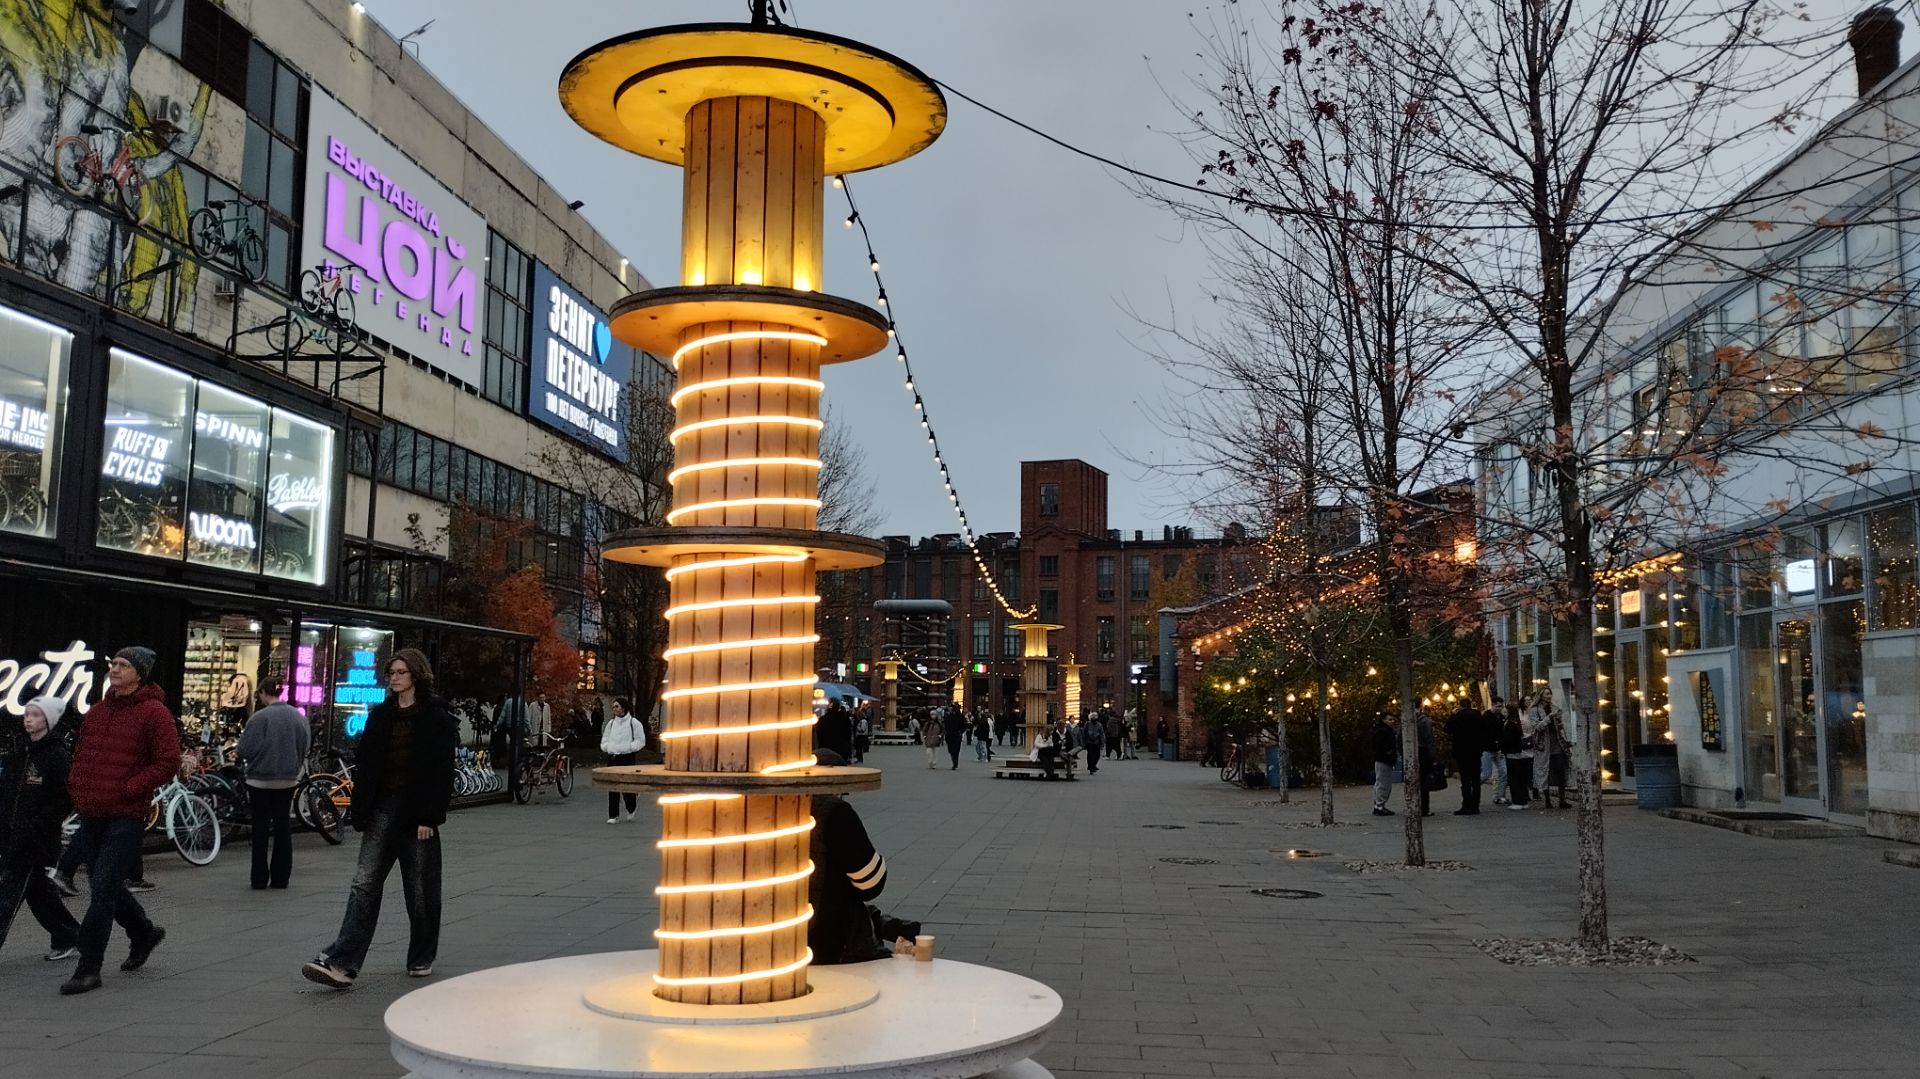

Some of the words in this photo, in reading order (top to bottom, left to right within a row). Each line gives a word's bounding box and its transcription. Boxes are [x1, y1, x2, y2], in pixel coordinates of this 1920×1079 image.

[327, 134, 440, 237] ВЫСТАВКА
[323, 171, 477, 334] ЦОЙ
[323, 258, 473, 357] ЛЕГЕНДА
[548, 285, 595, 357] ЗЕНИТ
[546, 337, 620, 422] ПЕТЕРБУРГ
[102, 452, 166, 486] CYCLES
[112, 426, 153, 456] RUFF
[195, 411, 264, 449] SPINN
